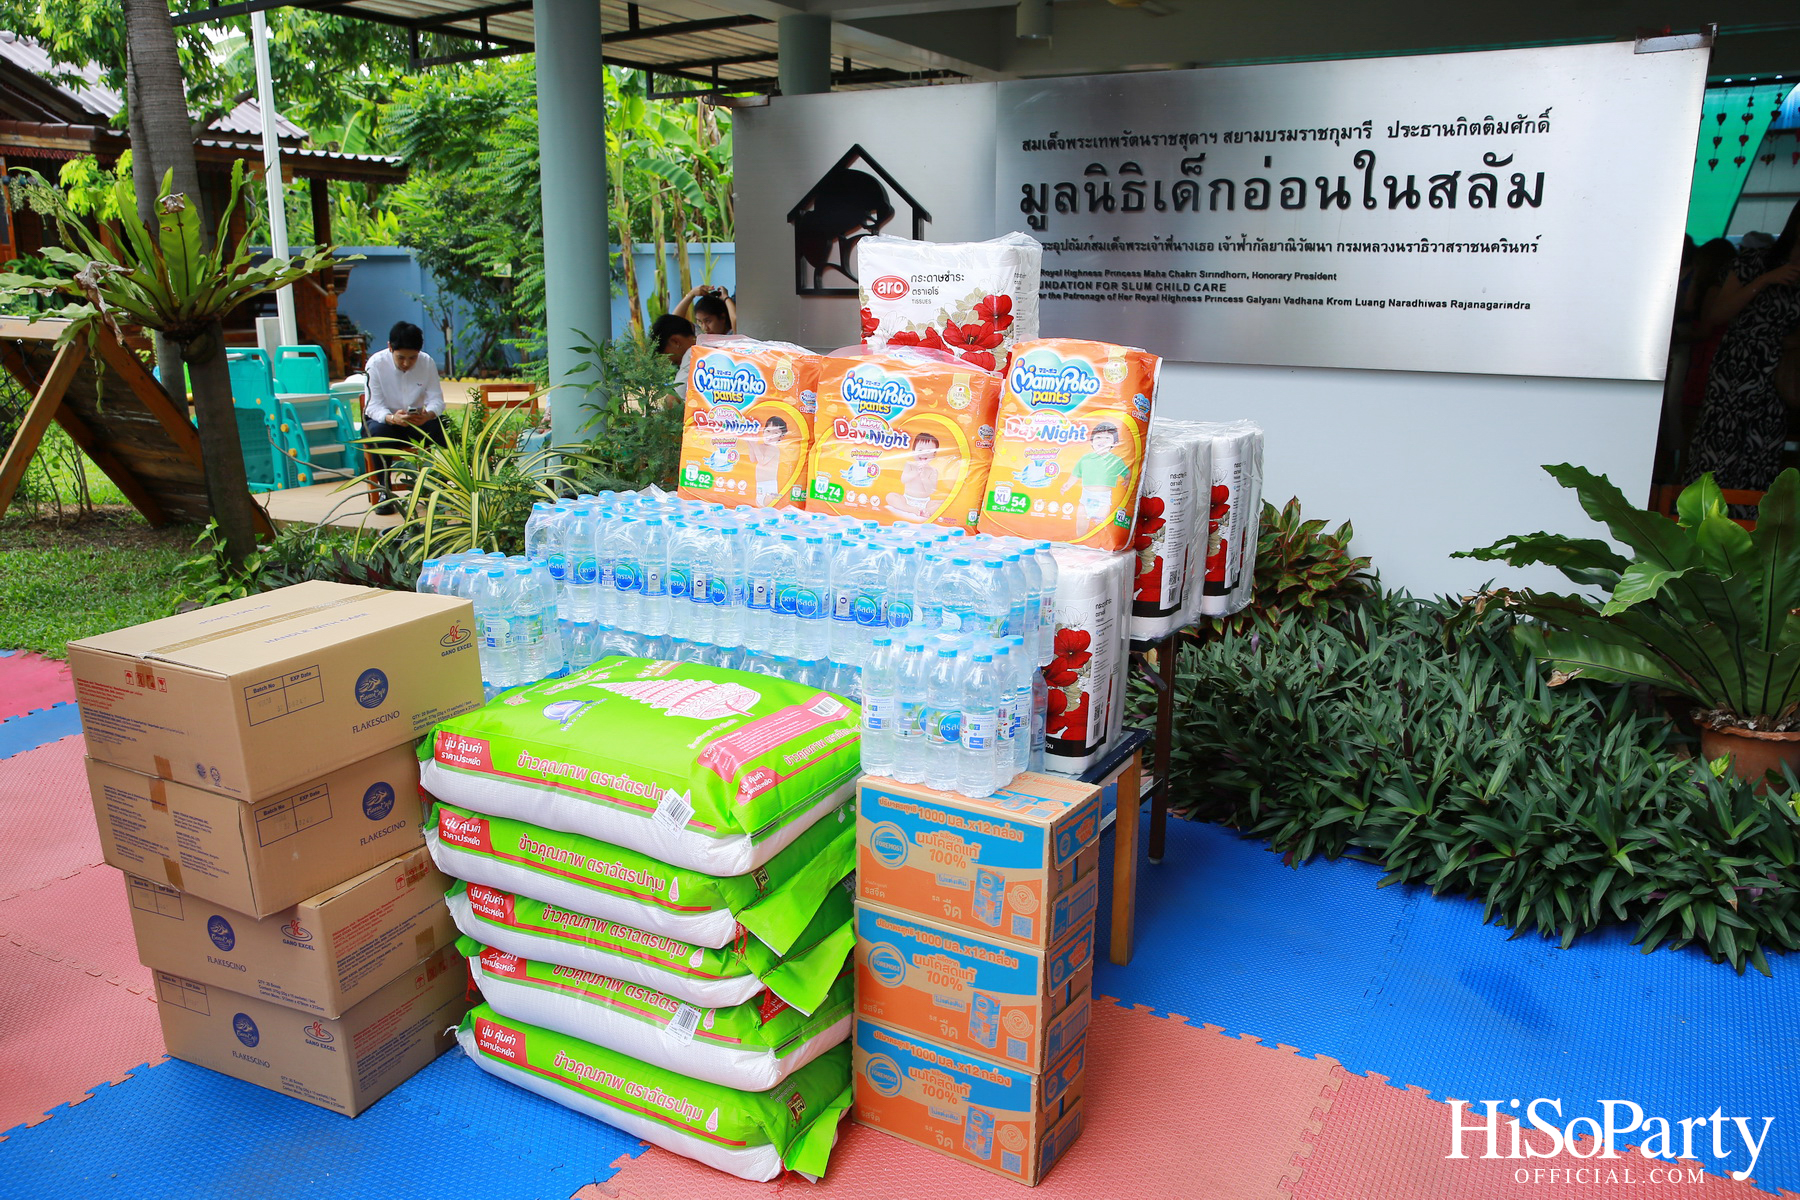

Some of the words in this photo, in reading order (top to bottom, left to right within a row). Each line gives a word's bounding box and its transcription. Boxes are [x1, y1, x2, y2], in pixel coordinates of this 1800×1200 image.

[1022, 130, 1218, 151] สมเด็จพระเทพรัตนราชสุดาฯ
[1223, 120, 1373, 146] สยามบรมราชกุมารี
[1387, 107, 1552, 139] ประธานกิตติมศักดิ์
[1020, 149, 1545, 231] มูลนิธิเด็กอ่อนในสลัม
[1218, 233, 1332, 252] เจ้าฟ้ากัลยาณิวัฒนา
[1337, 234, 1542, 253] กรมหลวงนราธิวาสราชนครินทร์
[911, 271, 965, 283] กระดาษชำระ
[1041, 269, 1063, 278] Royal
[1064, 269, 1102, 279] Highness
[1104, 270, 1141, 278] Princess
[1143, 270, 1166, 278] Maha
[1168, 270, 1197, 279] Chakri
[1199, 270, 1249, 279] Sirindhorn,
[1252, 272, 1292, 281] Honorary
[1294, 272, 1337, 281] President
[877, 280, 904, 294] aro
[1095, 281, 1118, 291] FOR
[1121, 281, 1152, 291] SLUM
[1155, 282, 1190, 292] CHILD
[1193, 283, 1226, 292] CARE
[1048, 292, 1061, 300] the
[1063, 292, 1105, 302] Patronage
[1107, 292, 1116, 300] of
[1118, 293, 1133, 301] Her
[1135, 294, 1159, 303] Royal
[1161, 294, 1202, 304] Highness
[1204, 295, 1243, 304] Princess
[1246, 295, 1281, 305] Galyani
[1283, 296, 1324, 306] Vadhana
[1326, 297, 1352, 306] Krom
[1355, 298, 1386, 308] Luang
[1388, 298, 1447, 308] Naradhiwas
[1450, 299, 1531, 310] Rajanagarindra
[694, 360, 766, 396] MamyPoko
[1011, 358, 1100, 395] MamyPoko
[713, 390, 744, 404] pants
[842, 371, 916, 408] MamyPoko
[1031, 391, 1070, 406] pants
[858, 401, 891, 414] pants
[698, 474, 711, 484] 62
[829, 486, 841, 498] 74
[996, 493, 1008, 503] XL
[1011, 496, 1026, 507] 54
[441, 647, 456, 657] GANO
[456, 642, 473, 653] EXCEL
[352, 710, 400, 734] FLAKESCINO
[444, 736, 457, 750] นุ่ม
[457, 736, 483, 753] คุ้มค่า
[441, 750, 481, 766] ราคาประหยัด
[517, 750, 589, 780] ข้าวคุณภาพ
[918, 808, 945, 824] 1000
[360, 820, 406, 846] FLAKESCINO
[442, 830, 481, 846] ราคาประหยัด
[916, 832, 982, 860] นมโคสดแท้
[518, 833, 585, 868] ข้าวคุณภาพ
[586, 860, 665, 893] ตราฉัตรปทุม
[929, 849, 967, 870] 100%
[470, 886, 481, 899] นุ่ม
[482, 886, 504, 907] คุ้มค่า
[943, 899, 962, 919] จืด
[542, 905, 608, 936] ข้าวคุณภาพ
[298, 943, 315, 951] EXCEL
[915, 929, 942, 947] 1000
[207, 956, 247, 973] FLAKESCINO
[913, 953, 977, 983] นมโคสดแท้
[926, 970, 963, 992] 100%
[482, 1025, 493, 1039] นุ่ม
[494, 1026, 516, 1046] คุ้มค่า
[939, 1019, 958, 1040] จืด
[480, 1038, 516, 1059] ราคาประหยัด
[910, 1045, 937, 1062] 1000
[232, 1050, 271, 1068] FLAKESCINO
[554, 1051, 624, 1090] ข้าวคุณภาพ
[625, 1080, 704, 1122] ตราฉัตรปทุม
[908, 1066, 972, 1097] นมโคสดแท้
[921, 1083, 958, 1105] 100%
[935, 1129, 954, 1149] จืด
